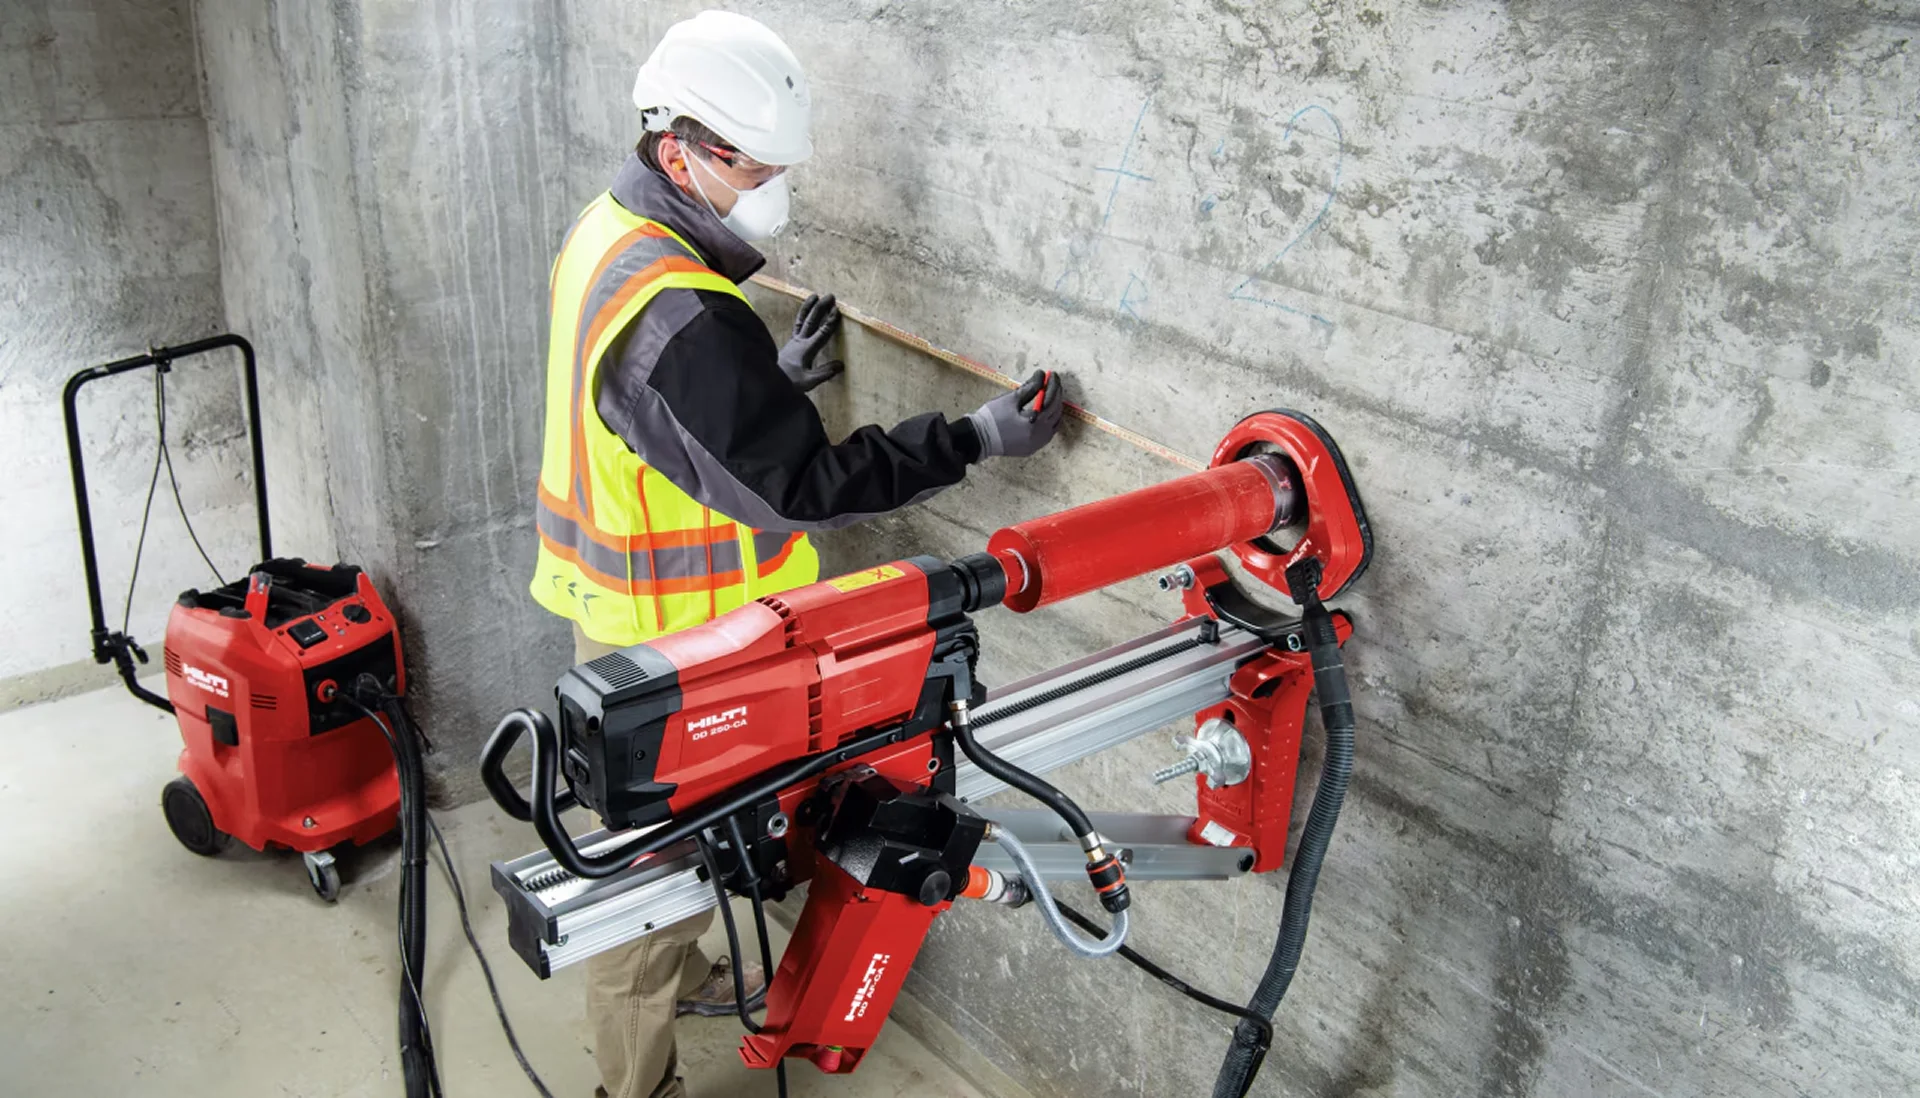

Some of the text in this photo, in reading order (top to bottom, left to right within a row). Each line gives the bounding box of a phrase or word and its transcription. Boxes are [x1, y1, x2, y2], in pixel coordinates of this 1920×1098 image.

[183, 663, 228, 690] HILTI
[688, 705, 747, 732] HILTI
[692, 719, 747, 741] DD 250-CA
[844, 953, 882, 1021] HILTI
